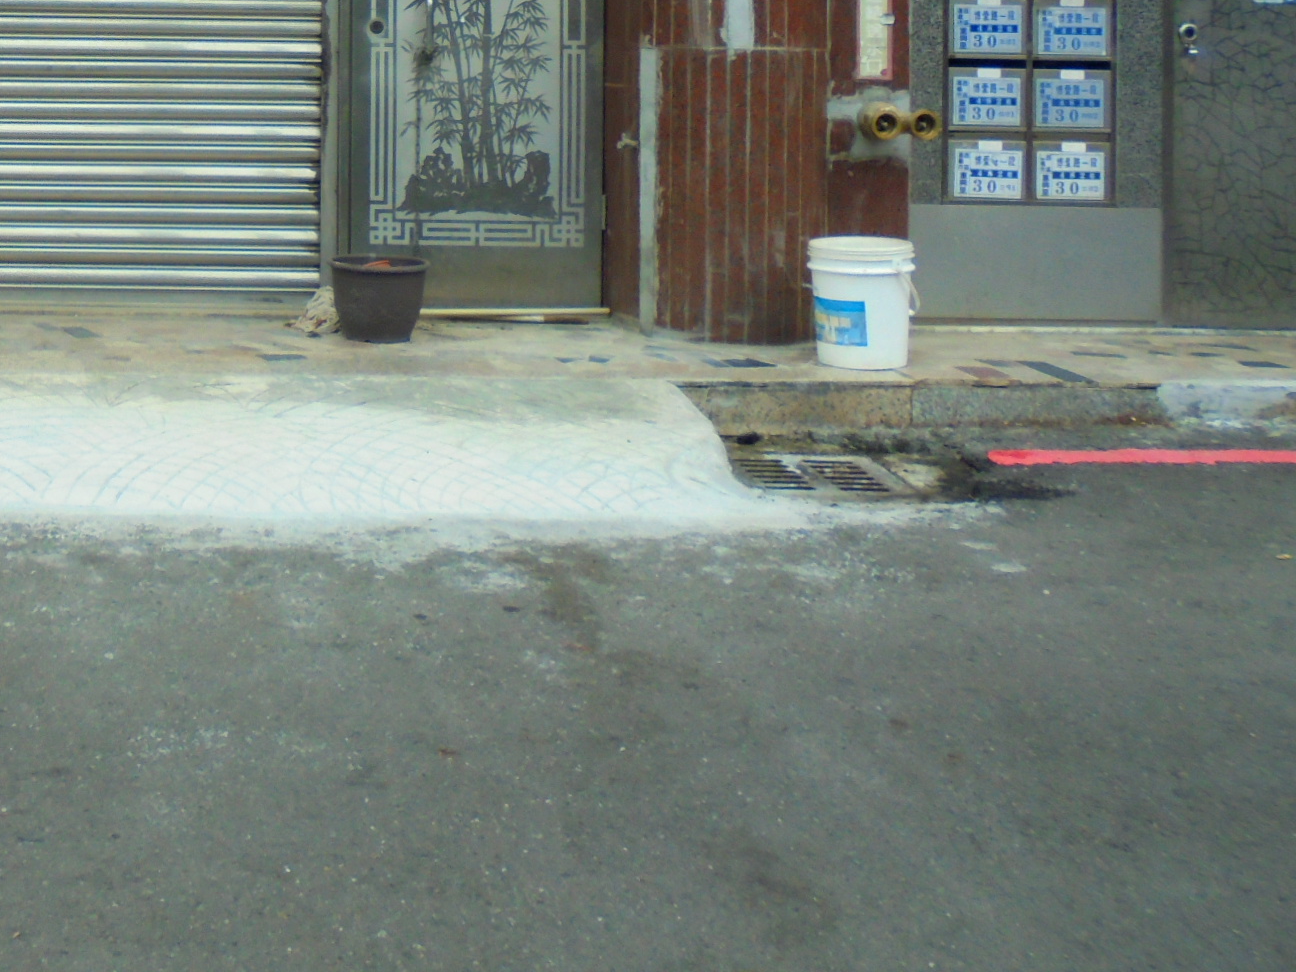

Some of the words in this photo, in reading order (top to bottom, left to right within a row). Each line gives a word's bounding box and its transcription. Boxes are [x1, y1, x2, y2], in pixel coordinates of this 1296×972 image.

[973, 35, 997, 47] 30
[1057, 37, 1081, 50] 30
[972, 107, 996, 120] 30
[1055, 109, 1079, 122] 30
[973, 179, 997, 193] 30
[1055, 181, 1079, 195] 30
